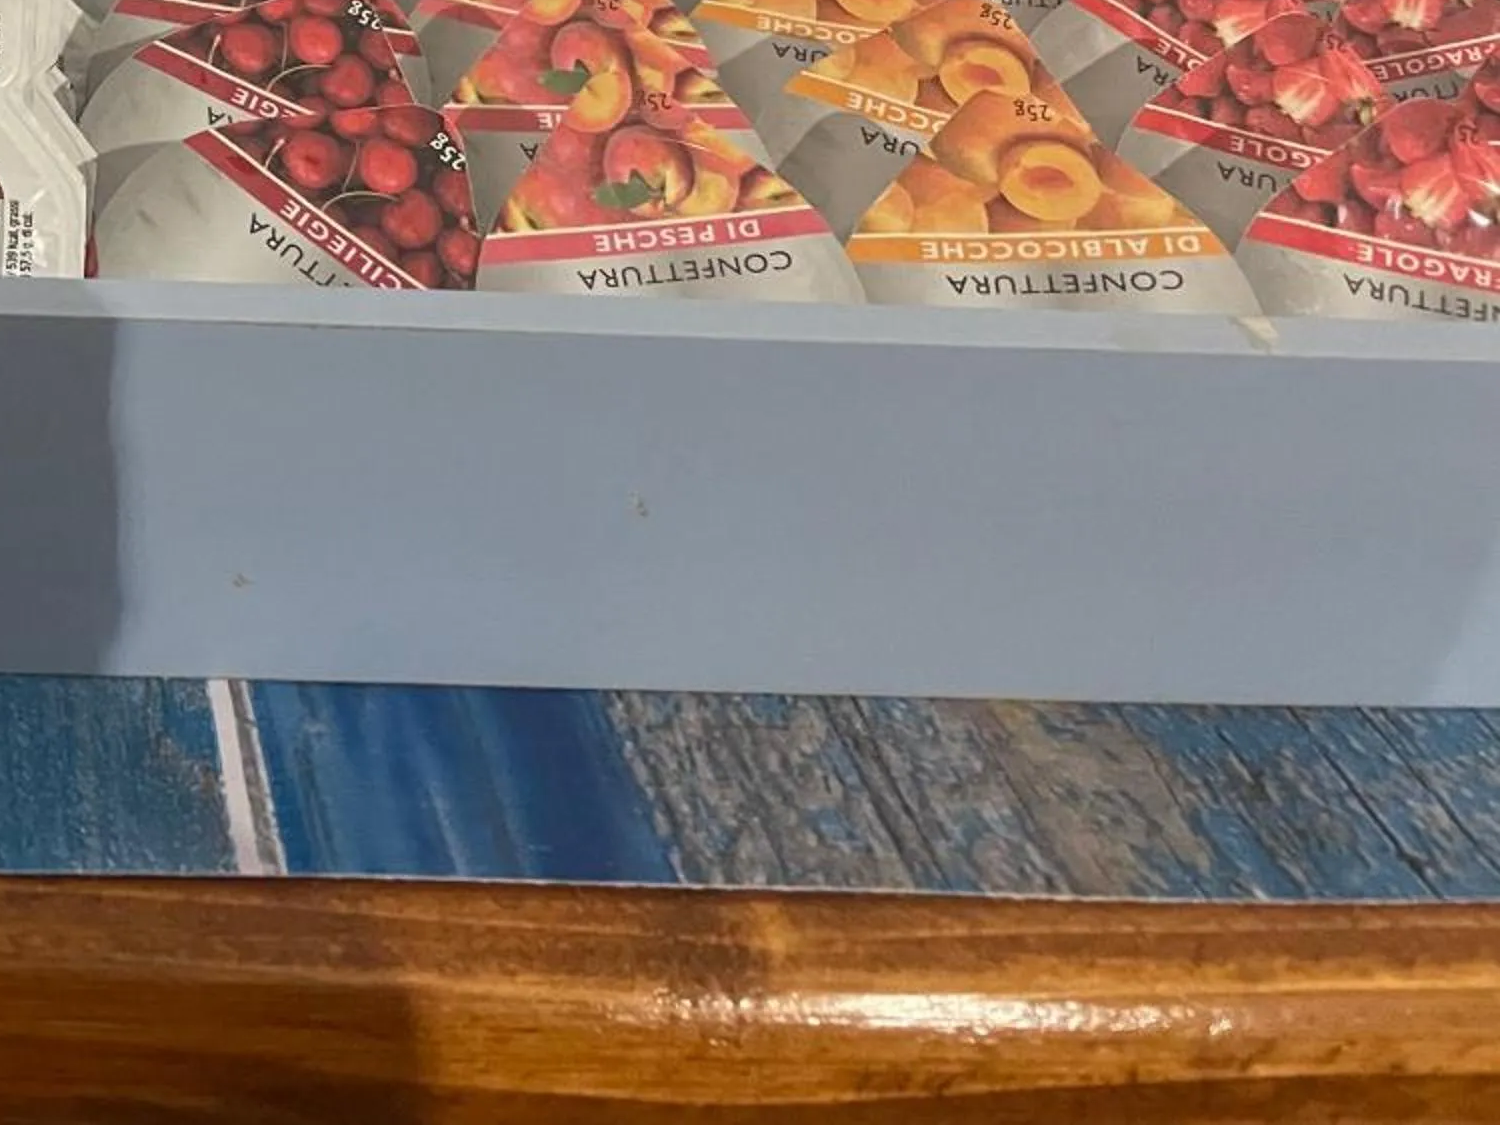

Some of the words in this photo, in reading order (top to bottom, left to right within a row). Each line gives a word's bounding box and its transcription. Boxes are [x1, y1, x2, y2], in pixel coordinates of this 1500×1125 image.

[979, 2, 1013, 31] 25g
[1012, 98, 1052, 123] 25g
[427, 130, 468, 173] 25g
[593, 223, 716, 253] PESCHE
[724, 218, 761, 239] DI
[920, 238, 1147, 262] ALBICOCCHE
[1163, 235, 1200, 256] DI
[578, 249, 794, 291] CONFETTURA
[947, 269, 1185, 295] CONFETTURA
[1343, 273, 1500, 323] FETTURA
